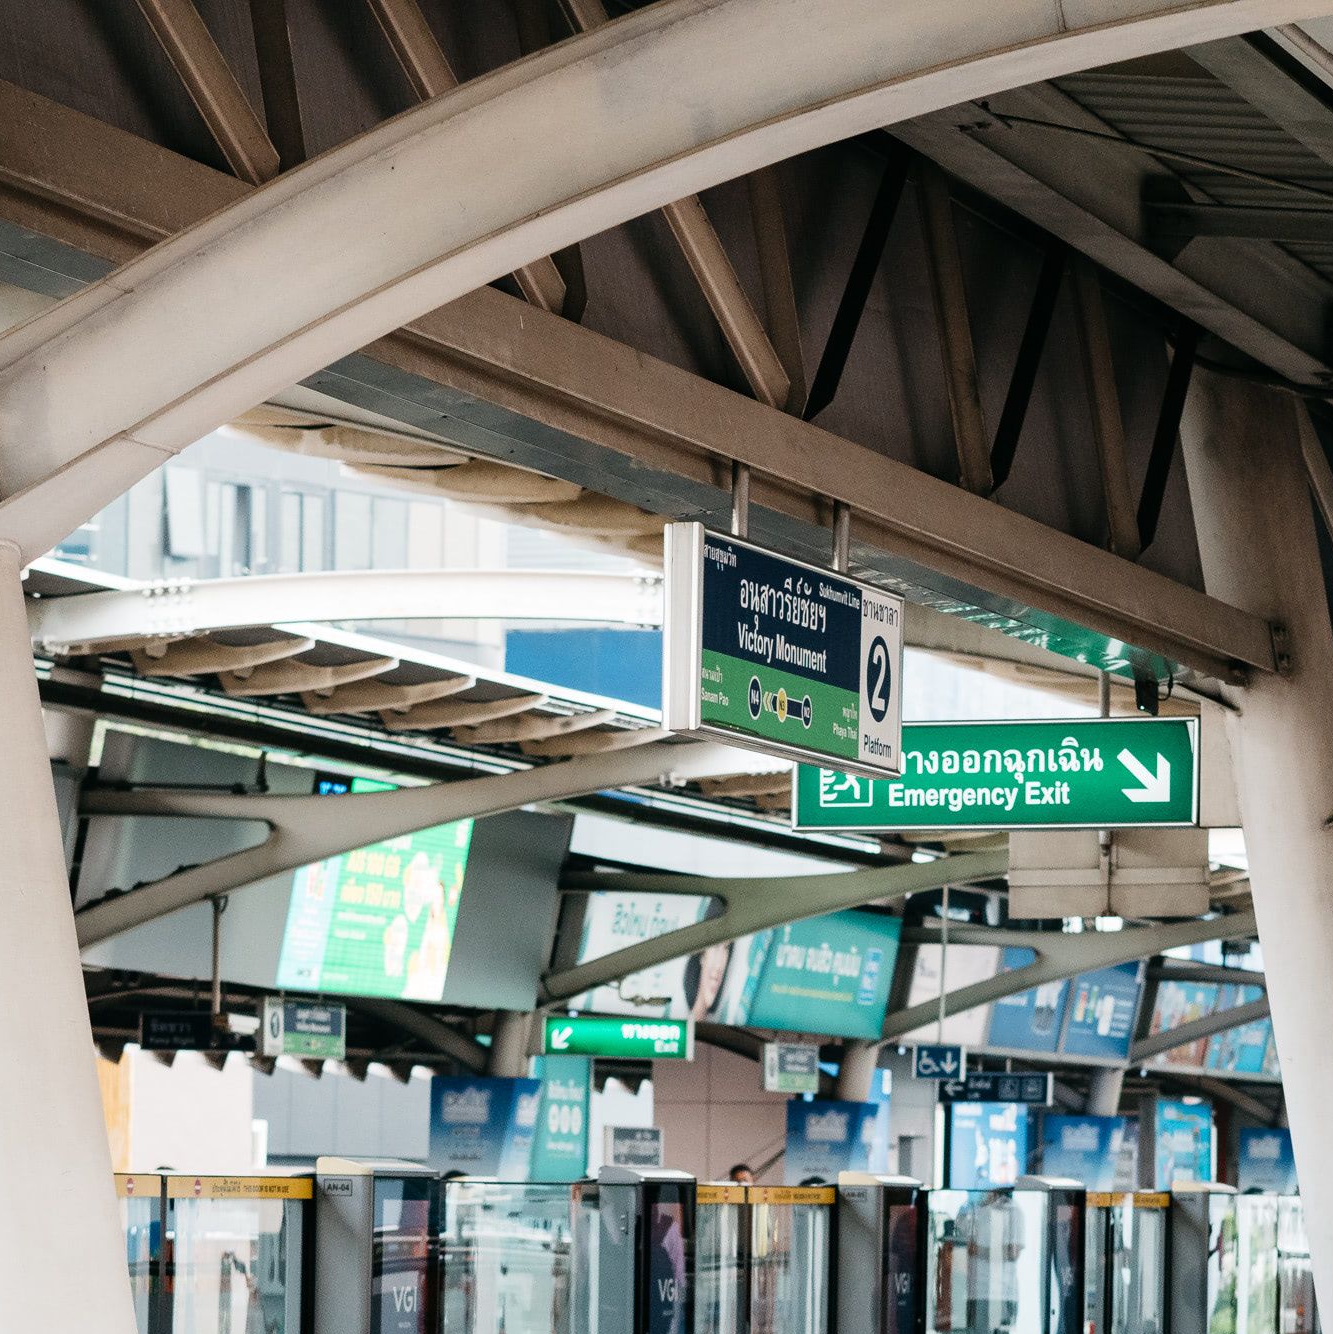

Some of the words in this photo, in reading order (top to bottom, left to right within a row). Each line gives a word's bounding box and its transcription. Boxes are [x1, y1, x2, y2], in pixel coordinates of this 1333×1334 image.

[740, 577, 827, 633] อนุสาวรีย์ชัยฯ
[819, 582, 848, 606] Sukhumvit
[848, 591, 861, 610] Line
[863, 599, 899, 628] ชานชาลา
[737, 622, 774, 664] Victory
[775, 634, 827, 674] Monument
[871, 644, 886, 712] 2
[718, 691, 729, 707] Pao
[750, 689, 760, 706] N4
[863, 734, 892, 759] Platform
[888, 783, 1018, 812] Emergency
[1025, 781, 1070, 805] Exit
[621, 1023, 681, 1041] ทางออก
[326, 1183, 350, 1192] AN-04
[393, 1286, 418, 1313] VGI
